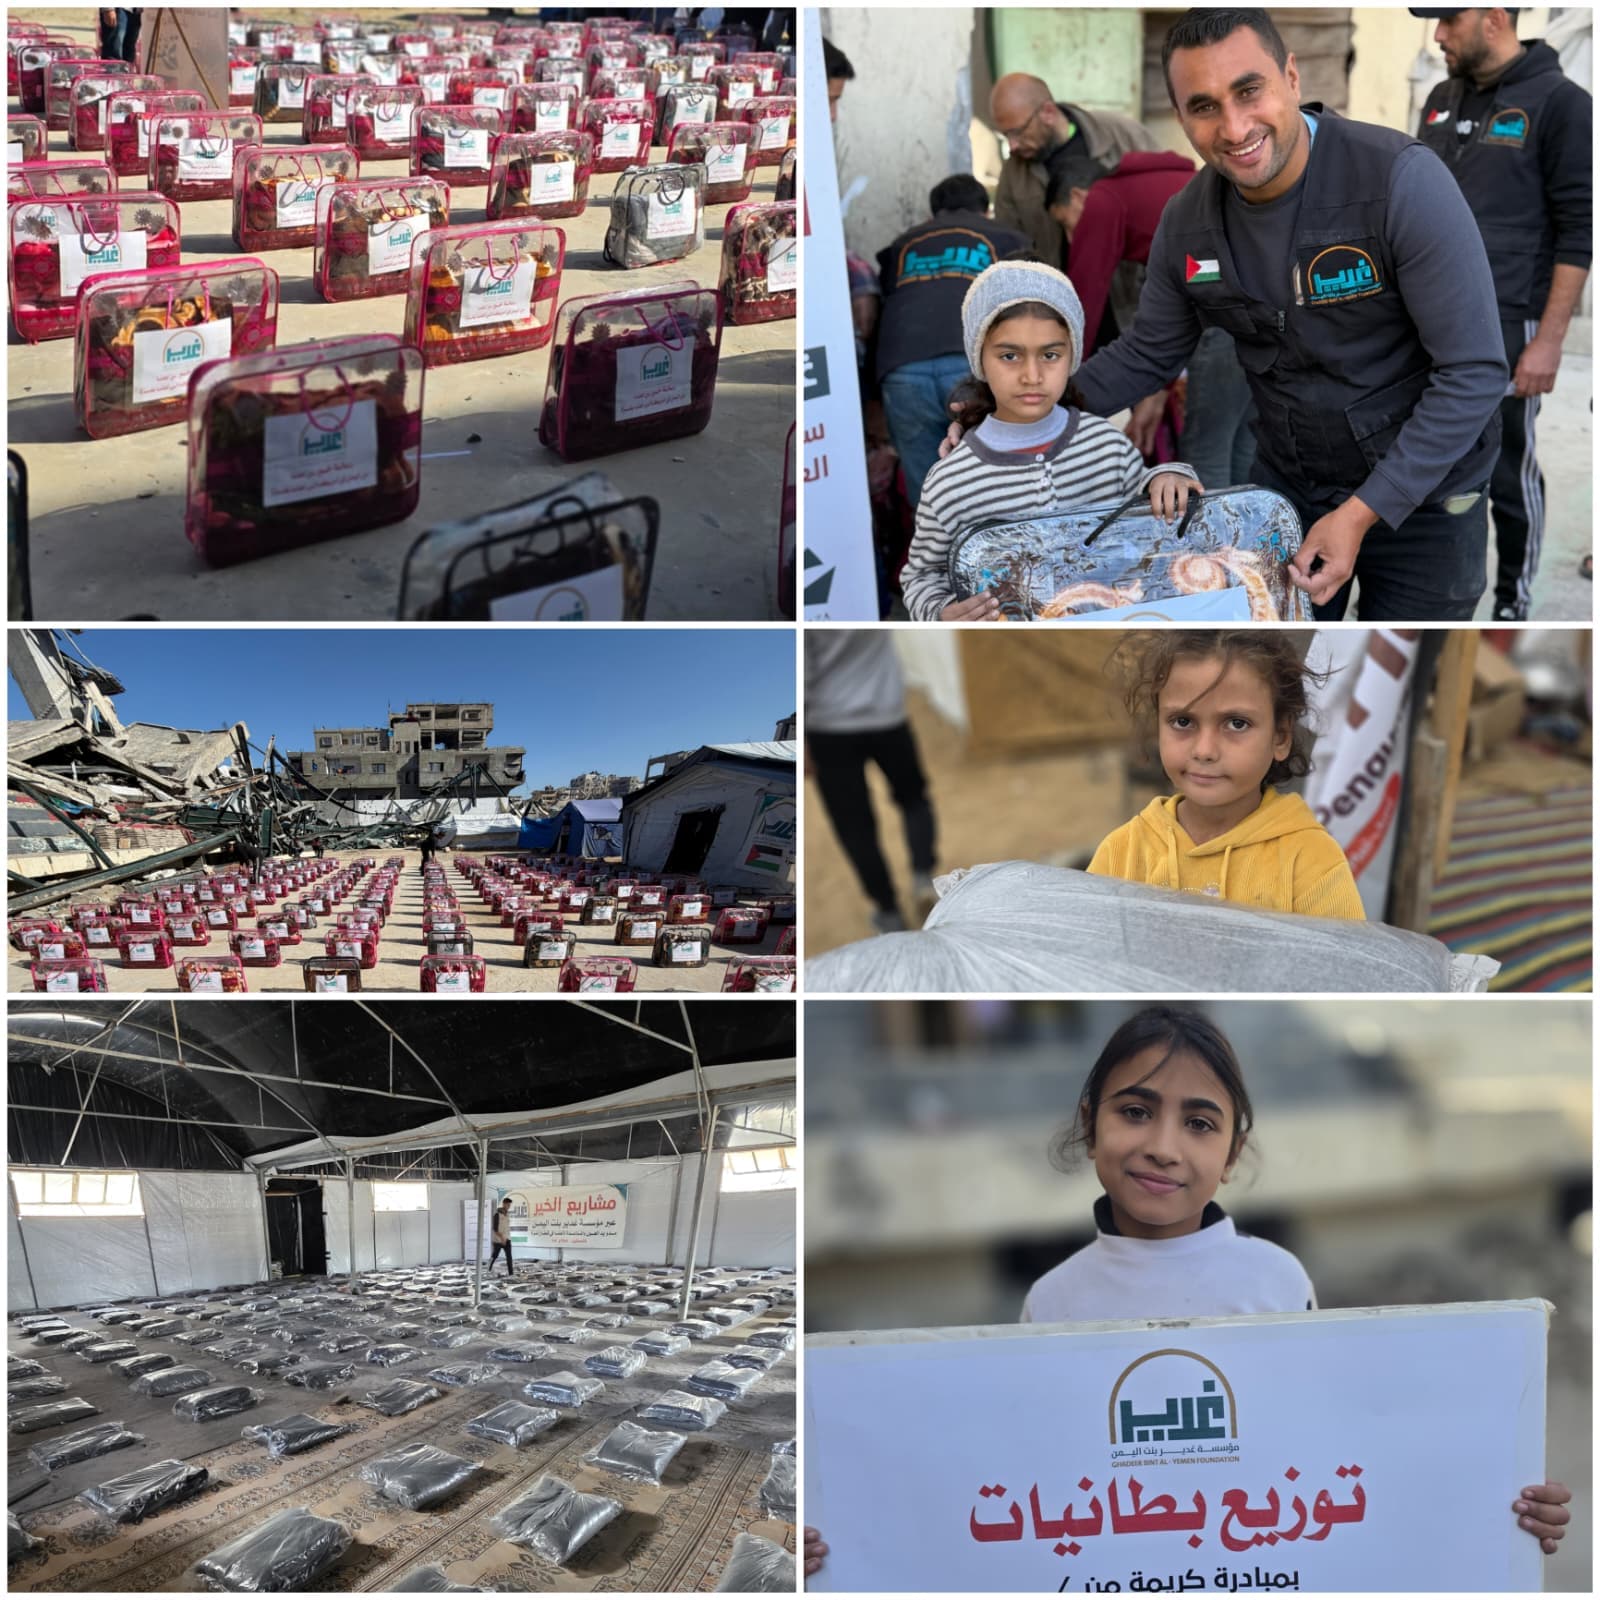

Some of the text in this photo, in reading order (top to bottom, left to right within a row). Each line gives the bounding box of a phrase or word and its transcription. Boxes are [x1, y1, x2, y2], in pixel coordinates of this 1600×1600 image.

[533, 1194, 617, 1216] مشاريع الخير
[1111, 1442, 1240, 1459] مؤسسة غدير بنت اليمن
[1111, 1459, 1143, 1468] GHADEER
[1143, 1459, 1159, 1467] BINT
[1172, 1457, 1196, 1465] YEMEN
[1197, 1455, 1240, 1464] FOUNDATION
[970, 1464, 1366, 1557] توزيع بطانيات
[1129, 1568, 1206, 1592] كريمة
[1214, 1567, 1299, 1592] بمبادرة
